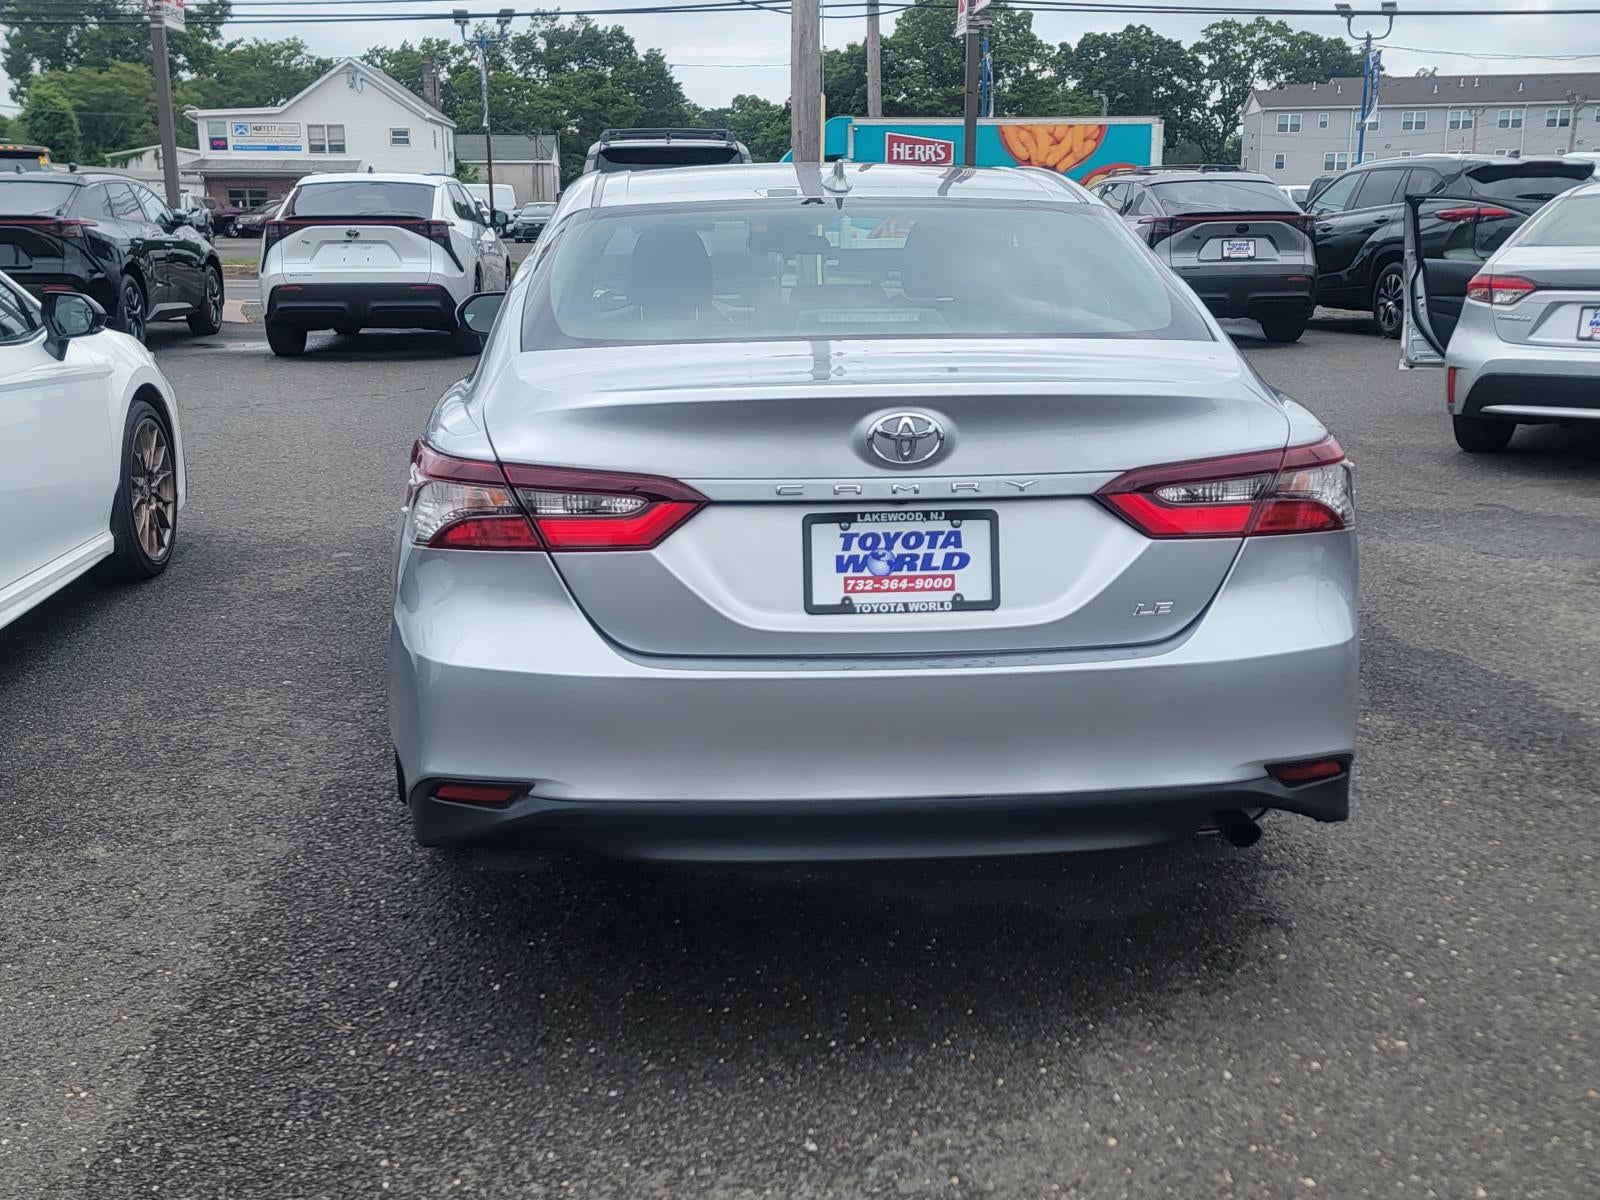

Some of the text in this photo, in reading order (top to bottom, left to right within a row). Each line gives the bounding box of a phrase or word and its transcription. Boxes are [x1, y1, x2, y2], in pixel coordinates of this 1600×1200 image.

[892, 142, 946, 162] HERR'S
[776, 479, 1039, 496] CAMRY
[857, 512, 945, 523] LAKEWOOD, NJ
[839, 530, 963, 551] TOYOTA
[835, 552, 971, 576] WORLD
[846, 577, 952, 591] 732-364-9000
[854, 601, 952, 613] TOYOTA WORLD
[1133, 602, 1174, 616] LE
